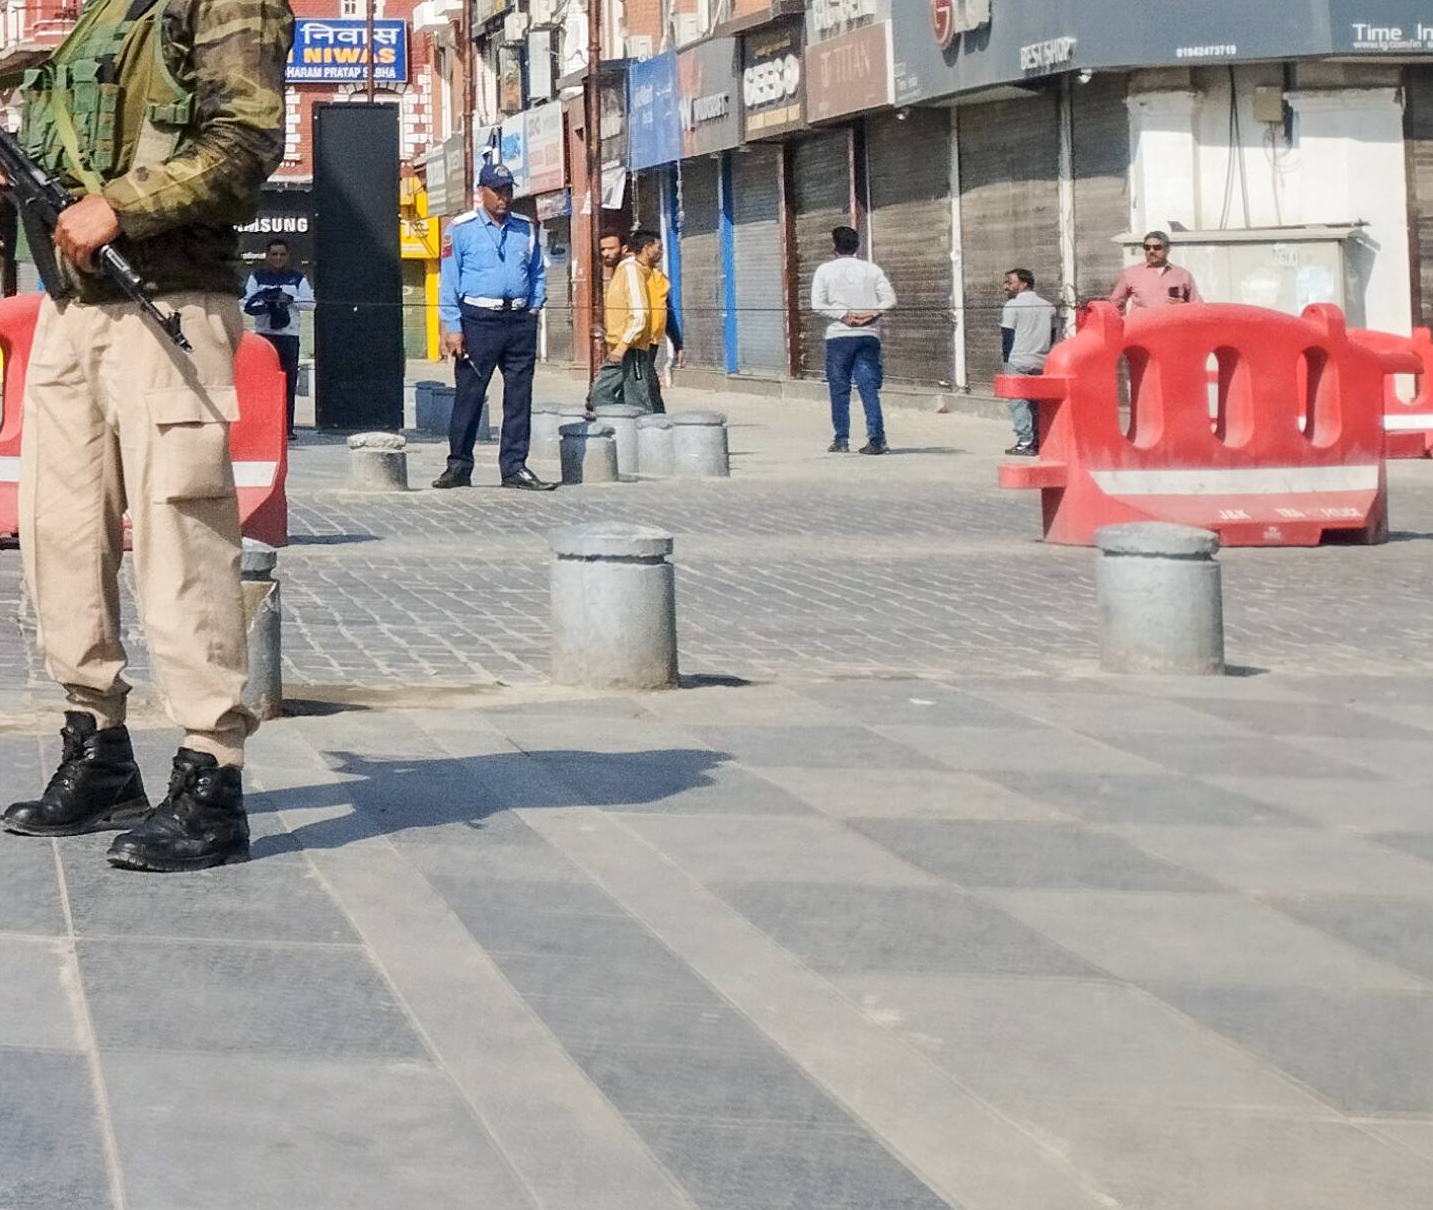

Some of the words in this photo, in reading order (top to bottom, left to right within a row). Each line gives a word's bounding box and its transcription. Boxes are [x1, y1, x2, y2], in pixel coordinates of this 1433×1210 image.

[1352, 22, 1402, 41] Time
[834, 42, 871, 83] TITAN
[323, 66, 361, 78] PRATAP
[362, 66, 396, 78] SBHA
[233, 217, 308, 233] MSUNG
